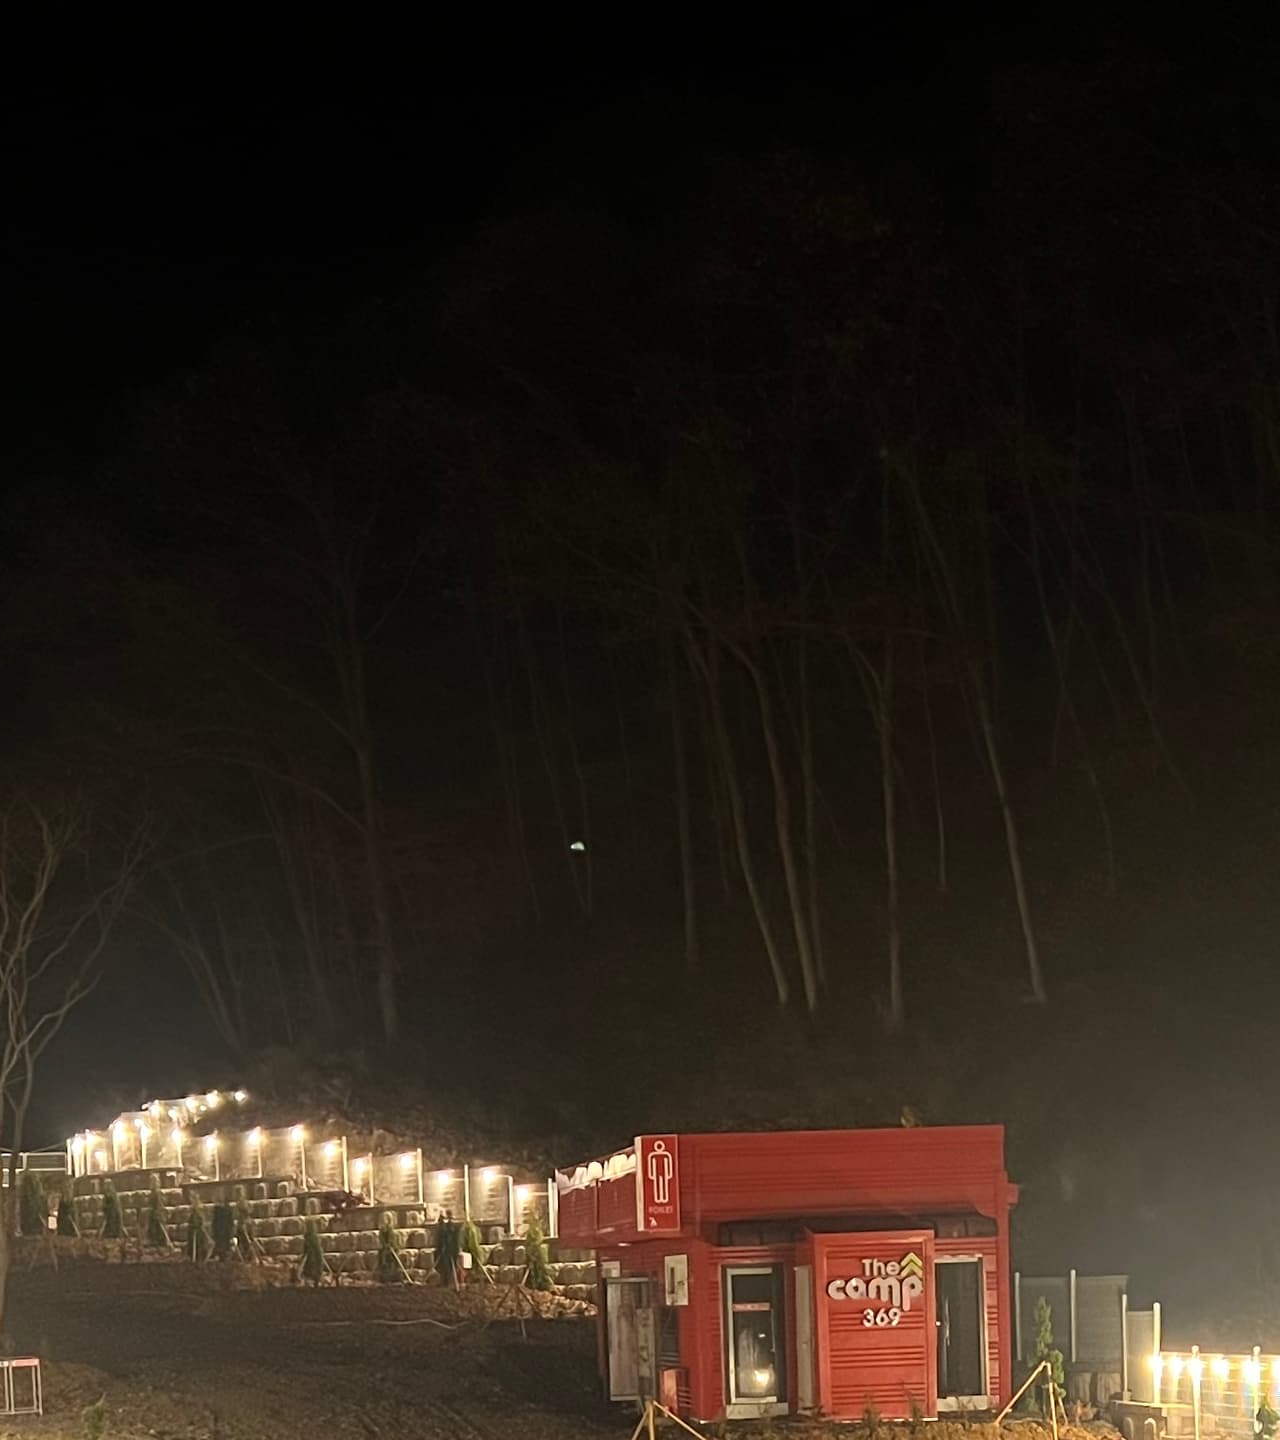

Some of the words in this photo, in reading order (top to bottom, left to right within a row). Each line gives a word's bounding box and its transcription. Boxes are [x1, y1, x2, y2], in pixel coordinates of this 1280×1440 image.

[861, 1258, 900, 1276] The
[827, 1275, 923, 1311] camp
[863, 1307, 901, 1328] 369
